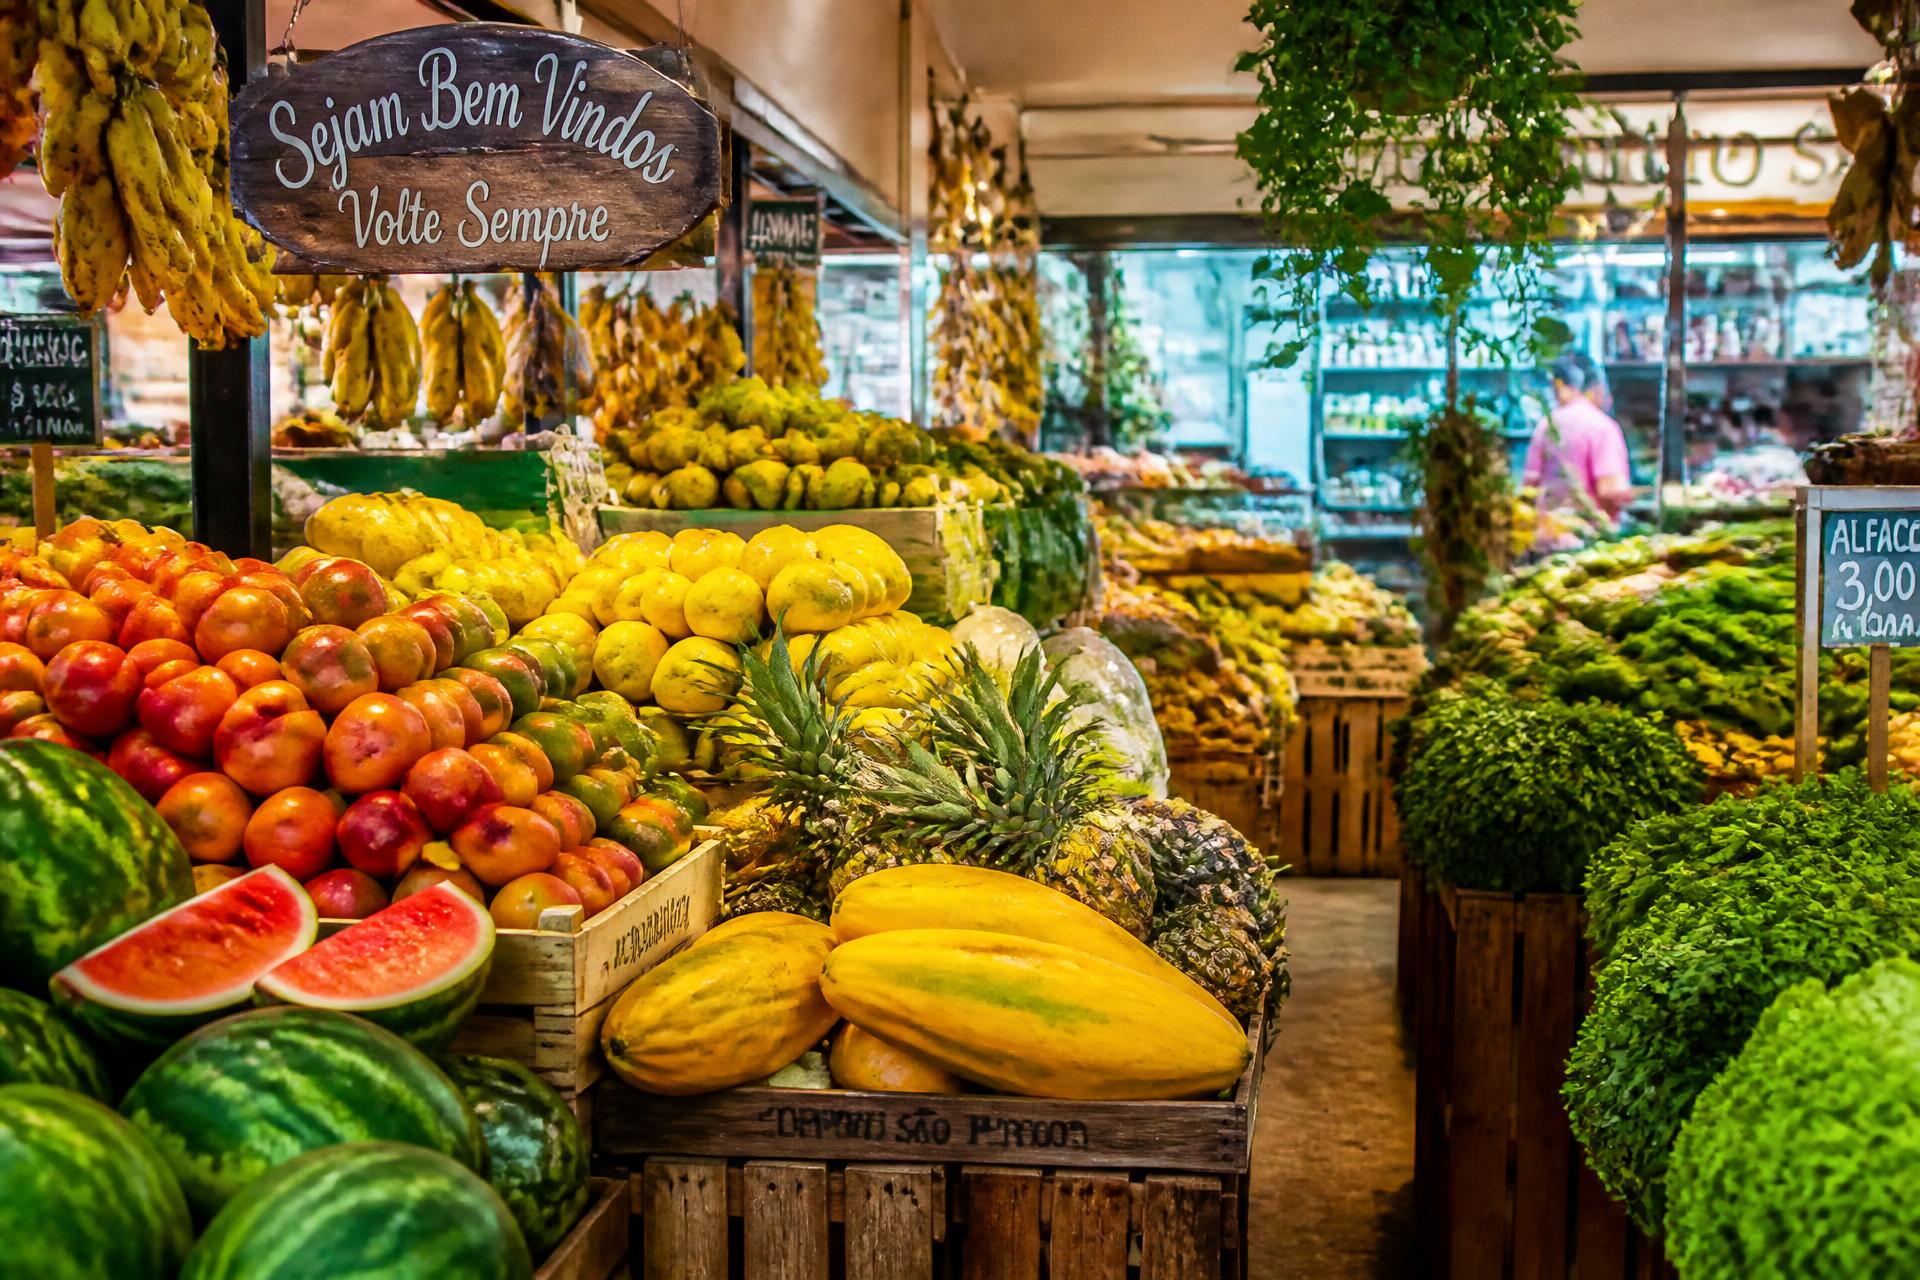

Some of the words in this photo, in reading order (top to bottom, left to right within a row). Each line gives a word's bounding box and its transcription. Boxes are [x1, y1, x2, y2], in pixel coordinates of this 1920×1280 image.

[269, 90, 410, 190] Sejam
[418, 46, 523, 132] Bem
[534, 52, 676, 184] Vindos
[337, 185, 445, 249] Volte
[457, 180, 610, 271] Sempre
[1836, 560, 1916, 611] 3,00
